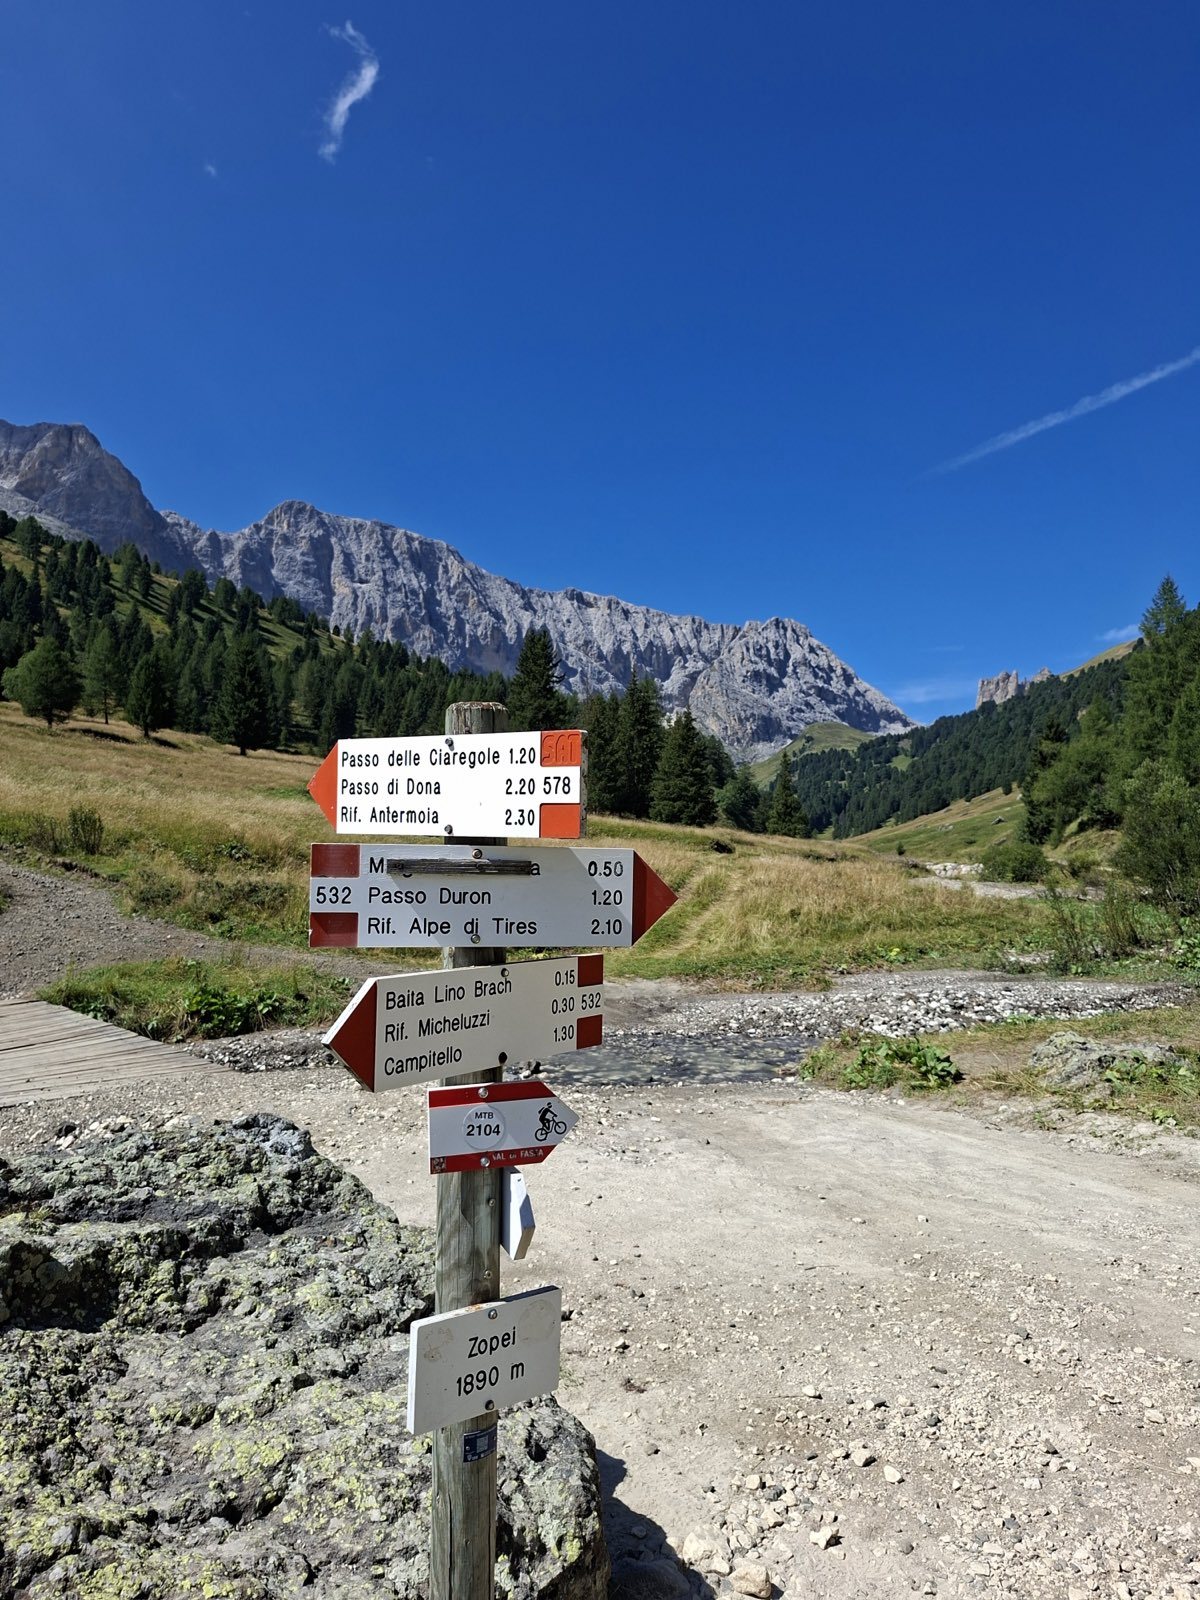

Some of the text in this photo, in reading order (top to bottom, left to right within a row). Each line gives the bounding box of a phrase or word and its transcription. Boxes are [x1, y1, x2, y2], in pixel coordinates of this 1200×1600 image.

[342, 747, 499, 768] Passo delle Ciaregole
[509, 748, 536, 764] 1.20
[543, 734, 580, 764] SAT
[341, 779, 441, 795] Passo di Dona
[505, 779, 535, 795] 2.20
[543, 777, 571, 794] 578
[341, 807, 439, 824] Rif. Antermoia
[505, 809, 535, 825] 2.30
[588, 861, 623, 877] 0.50
[316, 887, 352, 904] 532
[368, 887, 491, 905] Passo Duron
[591, 890, 622, 905] 1.20
[368, 918, 537, 937] Rif. Alpe di Tires
[591, 919, 622, 935] 2.10
[555, 970, 575, 986] 0.15
[386, 978, 512, 1010] Baita Lino Brach
[581, 992, 601, 1009] 532
[552, 997, 575, 1014] 0.30
[385, 1010, 490, 1042] Rif. Micheluzzi
[553, 1024, 574, 1042] 1.30
[384, 1047, 462, 1076] Campitello
[466, 1124, 500, 1136] 2104
[468, 1327, 516, 1358] Zopei
[457, 1362, 525, 1397] 1890 m
